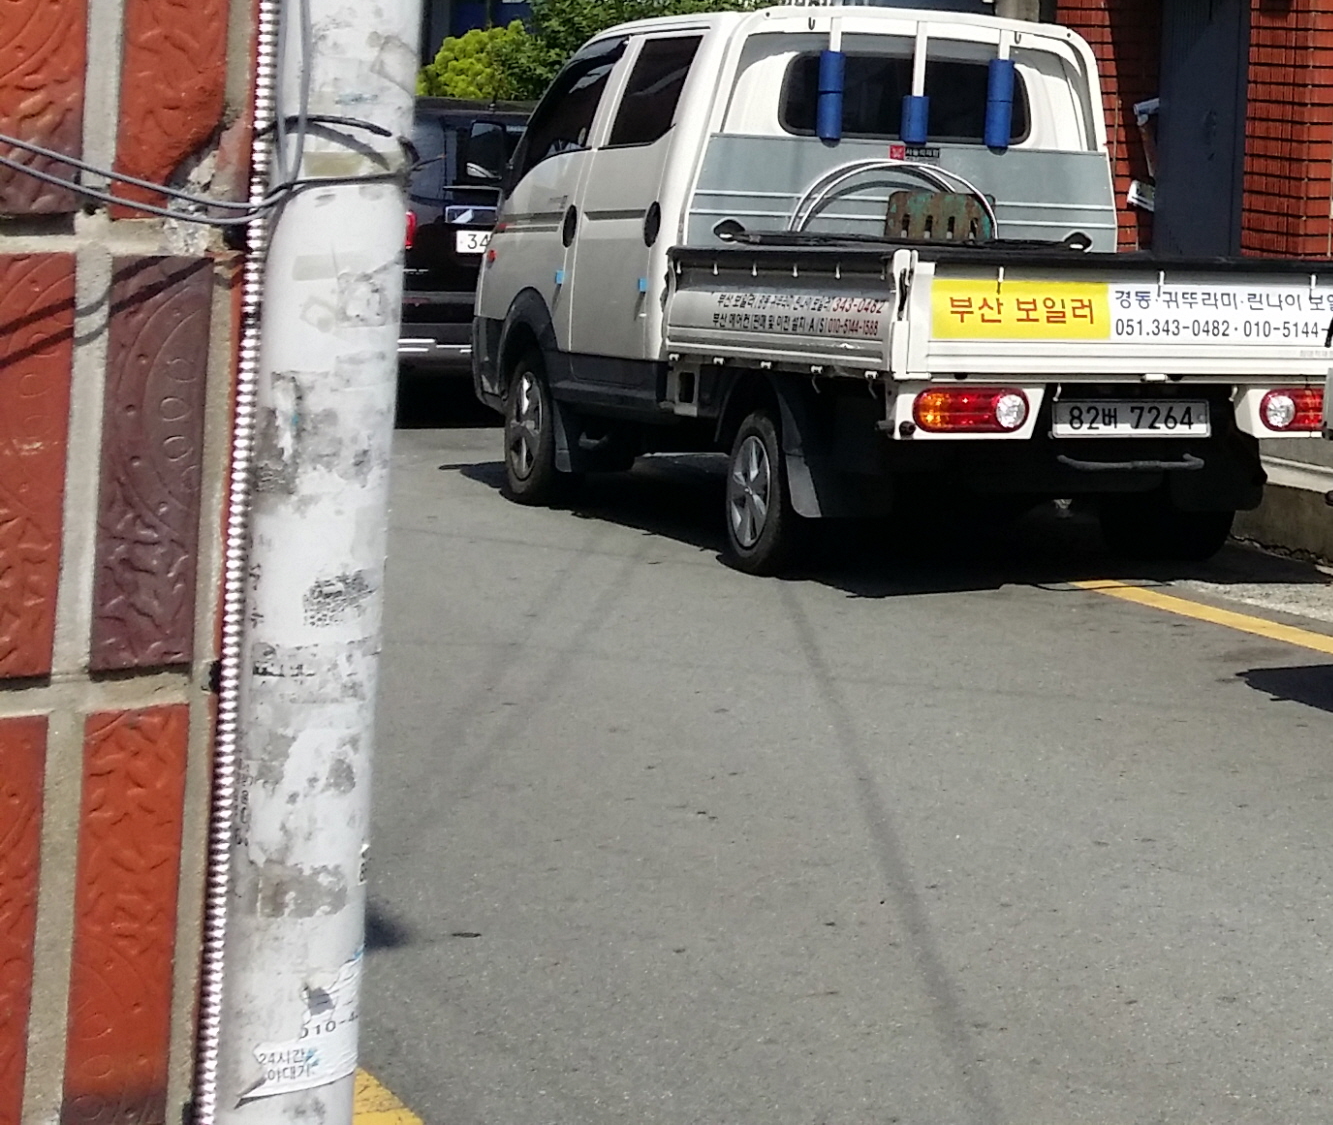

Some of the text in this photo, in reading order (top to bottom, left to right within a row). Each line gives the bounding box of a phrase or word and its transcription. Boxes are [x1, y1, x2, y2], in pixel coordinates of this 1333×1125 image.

[949, 296, 1094, 325] 부산 보일러
[1130, 406, 1194, 430] 7264
